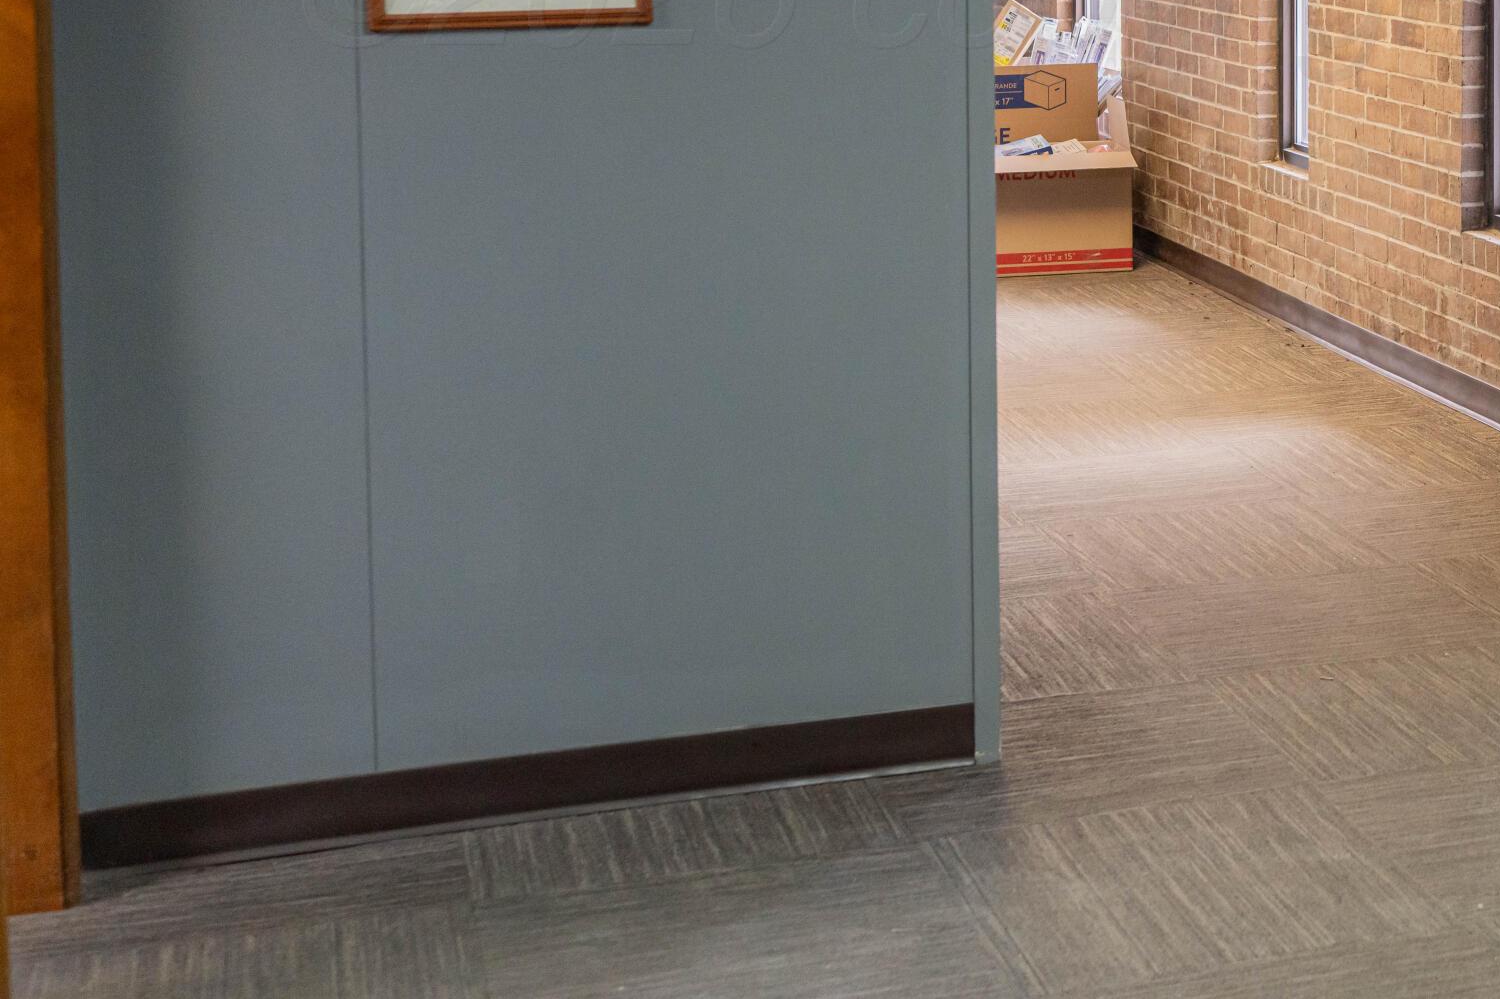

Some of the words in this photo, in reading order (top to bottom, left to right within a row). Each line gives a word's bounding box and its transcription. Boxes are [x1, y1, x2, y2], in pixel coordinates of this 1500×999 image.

[995, 127, 1011, 145] E
[1022, 254, 1036, 263] 22"
[1044, 253, 1056, 262] 13"
[1064, 252, 1076, 261] 15"
